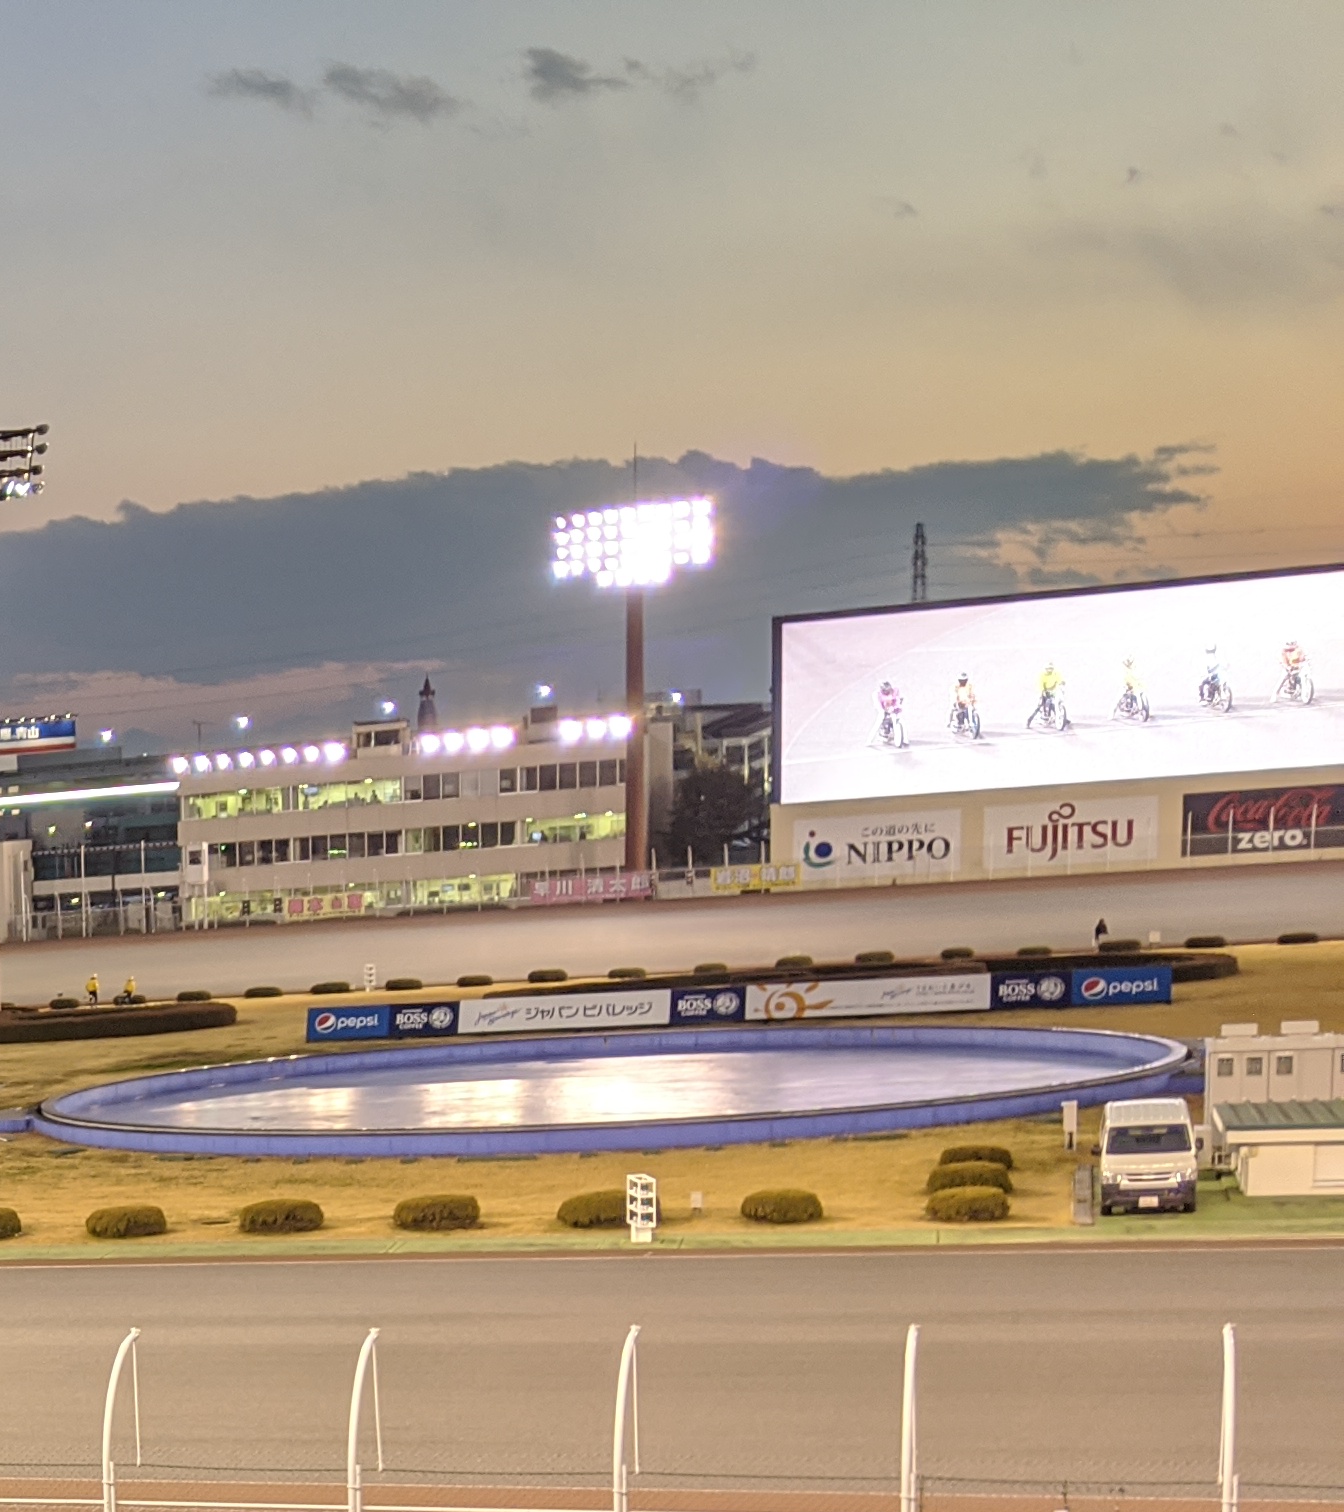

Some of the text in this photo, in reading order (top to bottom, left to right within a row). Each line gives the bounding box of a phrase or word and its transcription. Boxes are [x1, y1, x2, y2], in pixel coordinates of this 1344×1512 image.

[862, 823, 935, 838] この道の先に
[1006, 802, 1134, 862] FUJITSU
[847, 836, 951, 865] NIPPO
[998, 983, 1035, 998] BOSS
[1108, 977, 1159, 998] pepsi
[677, 998, 712, 1013] BOSS
[336, 1013, 379, 1030] pepsi
[396, 1012, 428, 1025] BOSS
